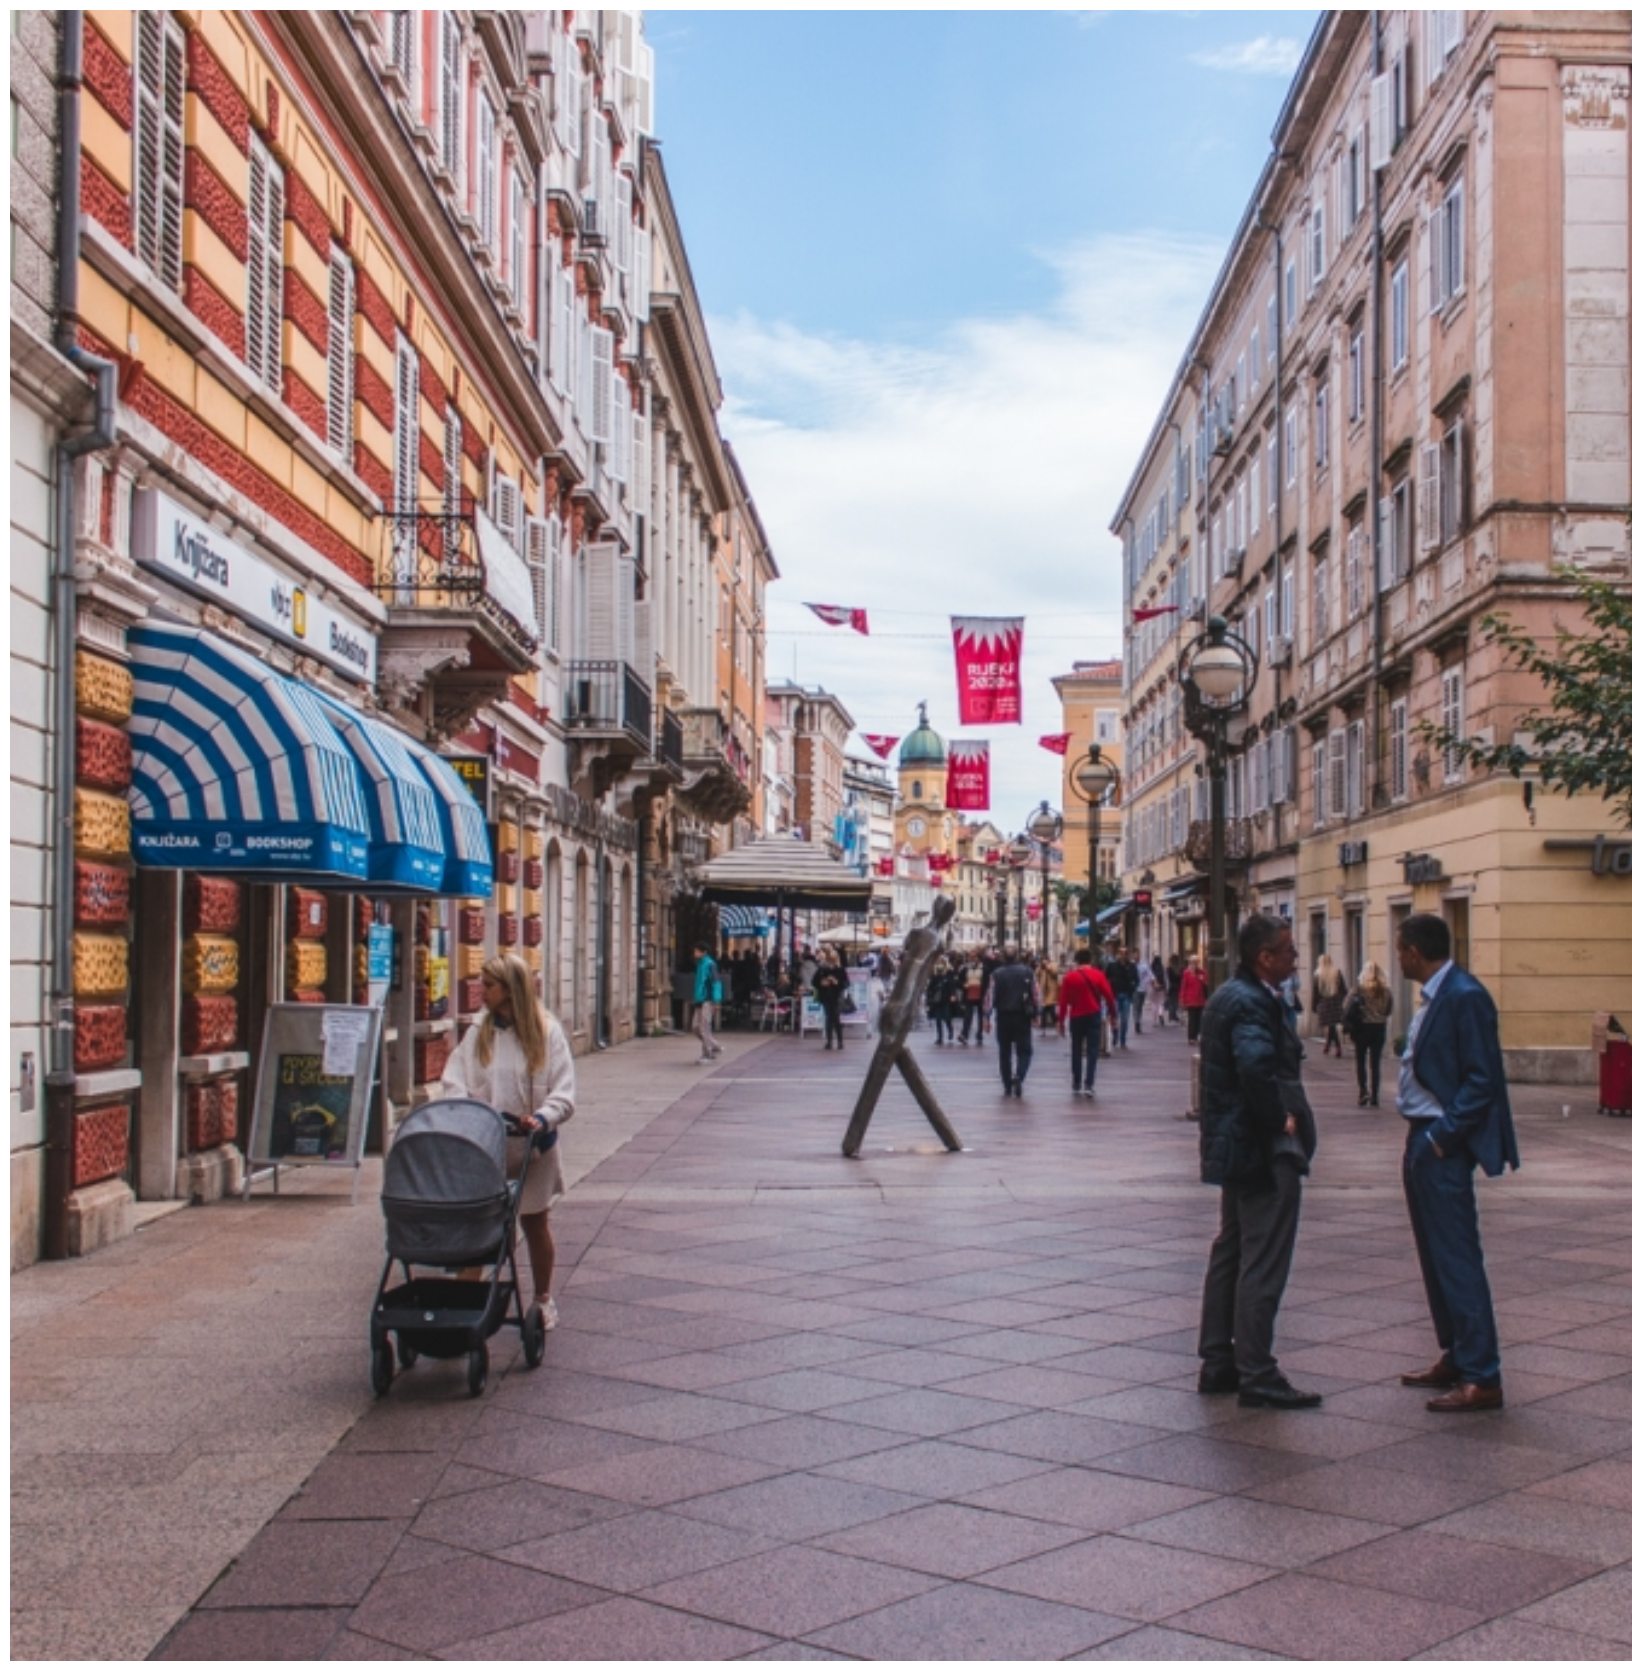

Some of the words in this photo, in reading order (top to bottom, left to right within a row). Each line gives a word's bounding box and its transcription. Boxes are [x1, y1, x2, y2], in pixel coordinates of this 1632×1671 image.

[174, 519, 229, 587] Knjižara
[329, 621, 368, 674] Bookshop
[453, 761, 484, 778] TEL
[138, 833, 200, 847] KNJIŽARA
[247, 836, 313, 849] BOOKSHOP
